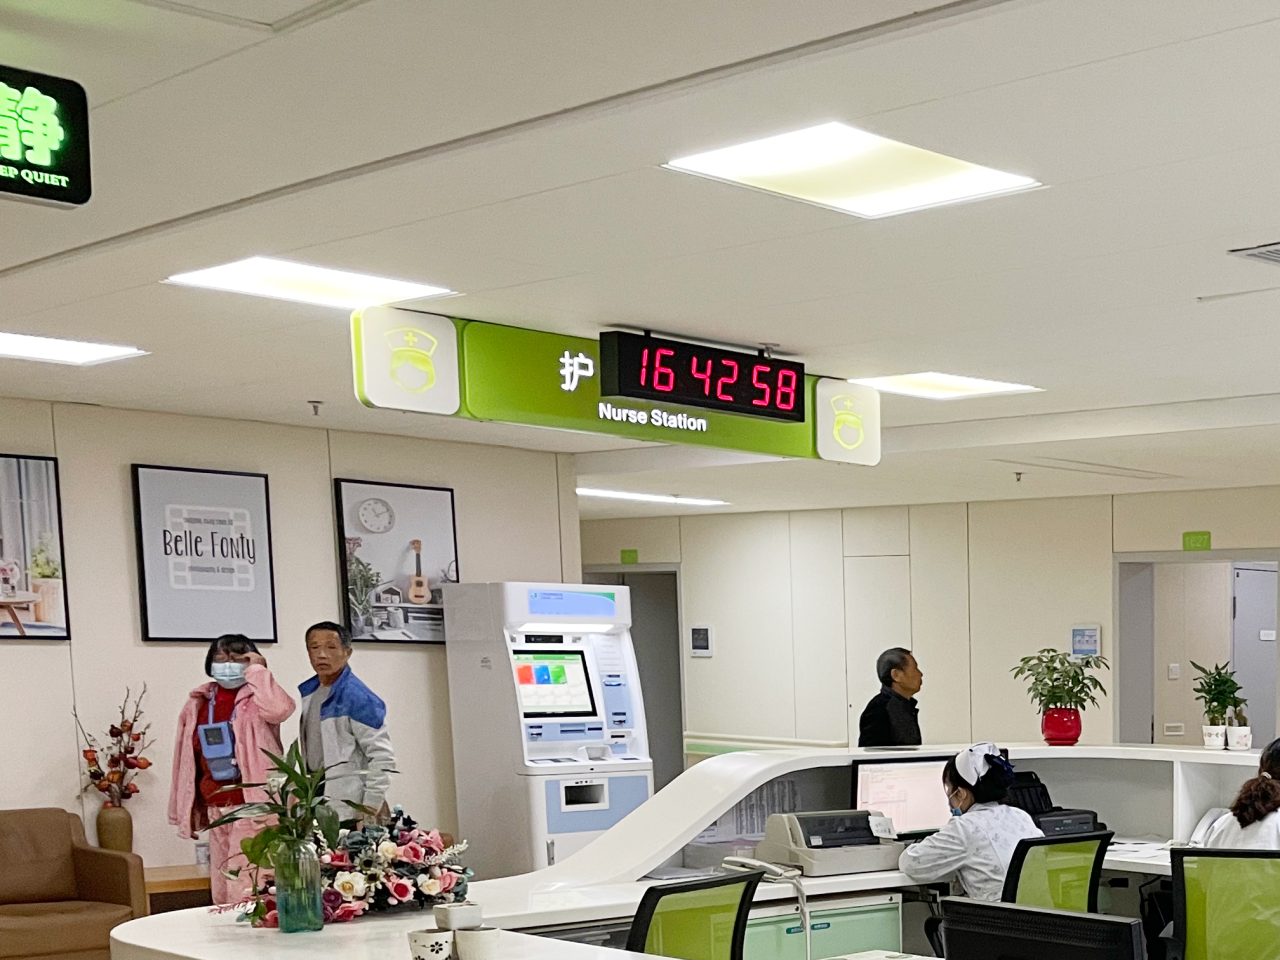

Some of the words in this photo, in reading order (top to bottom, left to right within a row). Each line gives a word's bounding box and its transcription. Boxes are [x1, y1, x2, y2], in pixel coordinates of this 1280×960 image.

[21, 169, 69, 187] QUIET
[559, 350, 594, 391] 护
[640, 348, 674, 391] 16
[691, 356, 738, 401] 42
[752, 365, 796, 410] 58
[599, 402, 648, 424] Nurse
[650, 409, 707, 432] Station
[162, 529, 204, 557] Belle
[210, 531, 256, 565] Fonty
